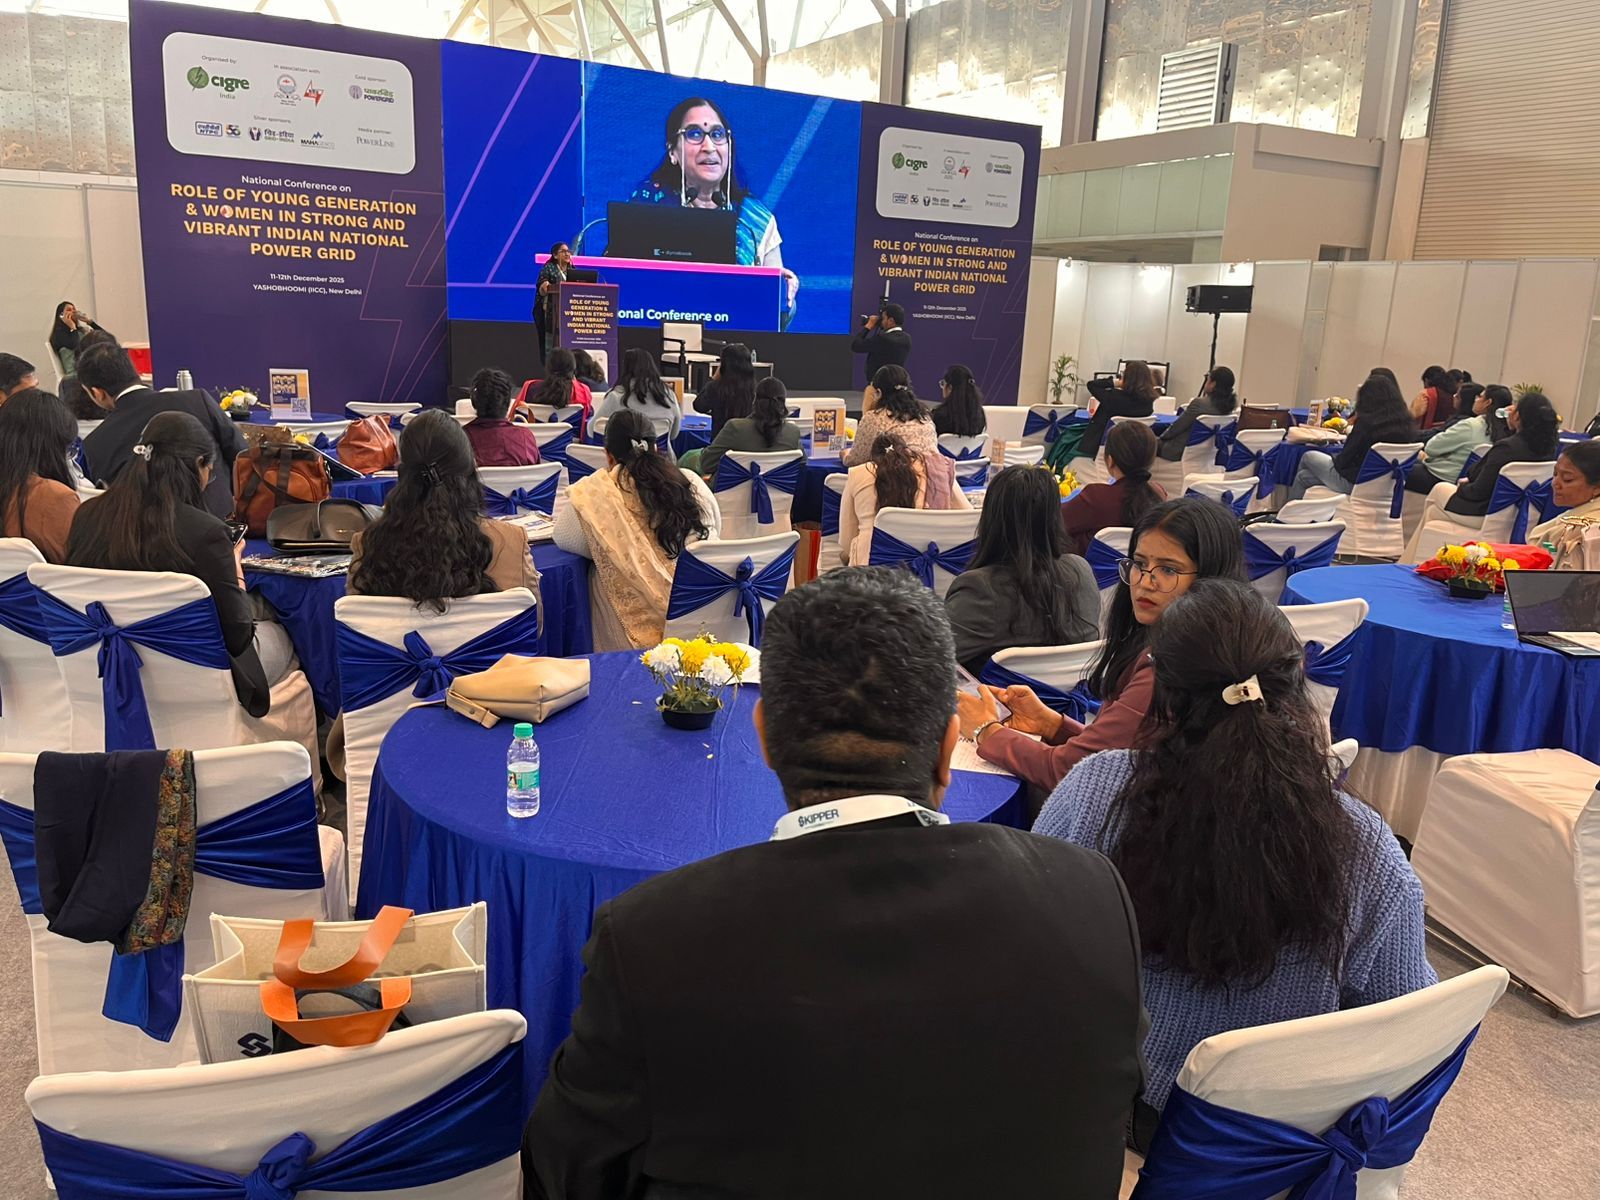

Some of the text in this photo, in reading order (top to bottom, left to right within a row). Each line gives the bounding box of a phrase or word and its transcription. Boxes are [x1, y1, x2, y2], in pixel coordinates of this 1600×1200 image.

[211, 76, 250, 92] cigre
[364, 94, 394, 104] POWERGRID
[906, 158, 928, 171] cigre
[241, 175, 282, 187] National
[284, 178, 338, 192] Conference
[170, 183, 416, 215] ROLE OF YOUNG GENERATION
[186, 203, 406, 231] & WOMEN IN STRONG AND
[184, 220, 408, 248] VIBRANT INDIAN NATIONAL
[914, 232, 938, 240] National
[939, 234, 970, 242] Conference
[250, 242, 356, 261] POWER GRID
[874, 239, 1016, 259] ROLE OF YOUNG GENERATION
[880, 254, 1008, 271] & WOMEN IN STRONG AND
[293, 274, 328, 283] December
[329, 276, 345, 284] 2025
[878, 267, 1008, 284] VIBRANT INDIAN NATIONAL
[253, 284, 307, 293] YASHOBHOOMI
[914, 282, 976, 294] POWER GRID
[618, 308, 729, 322] onal Conference on
[798, 809, 839, 827] SKIPPER
